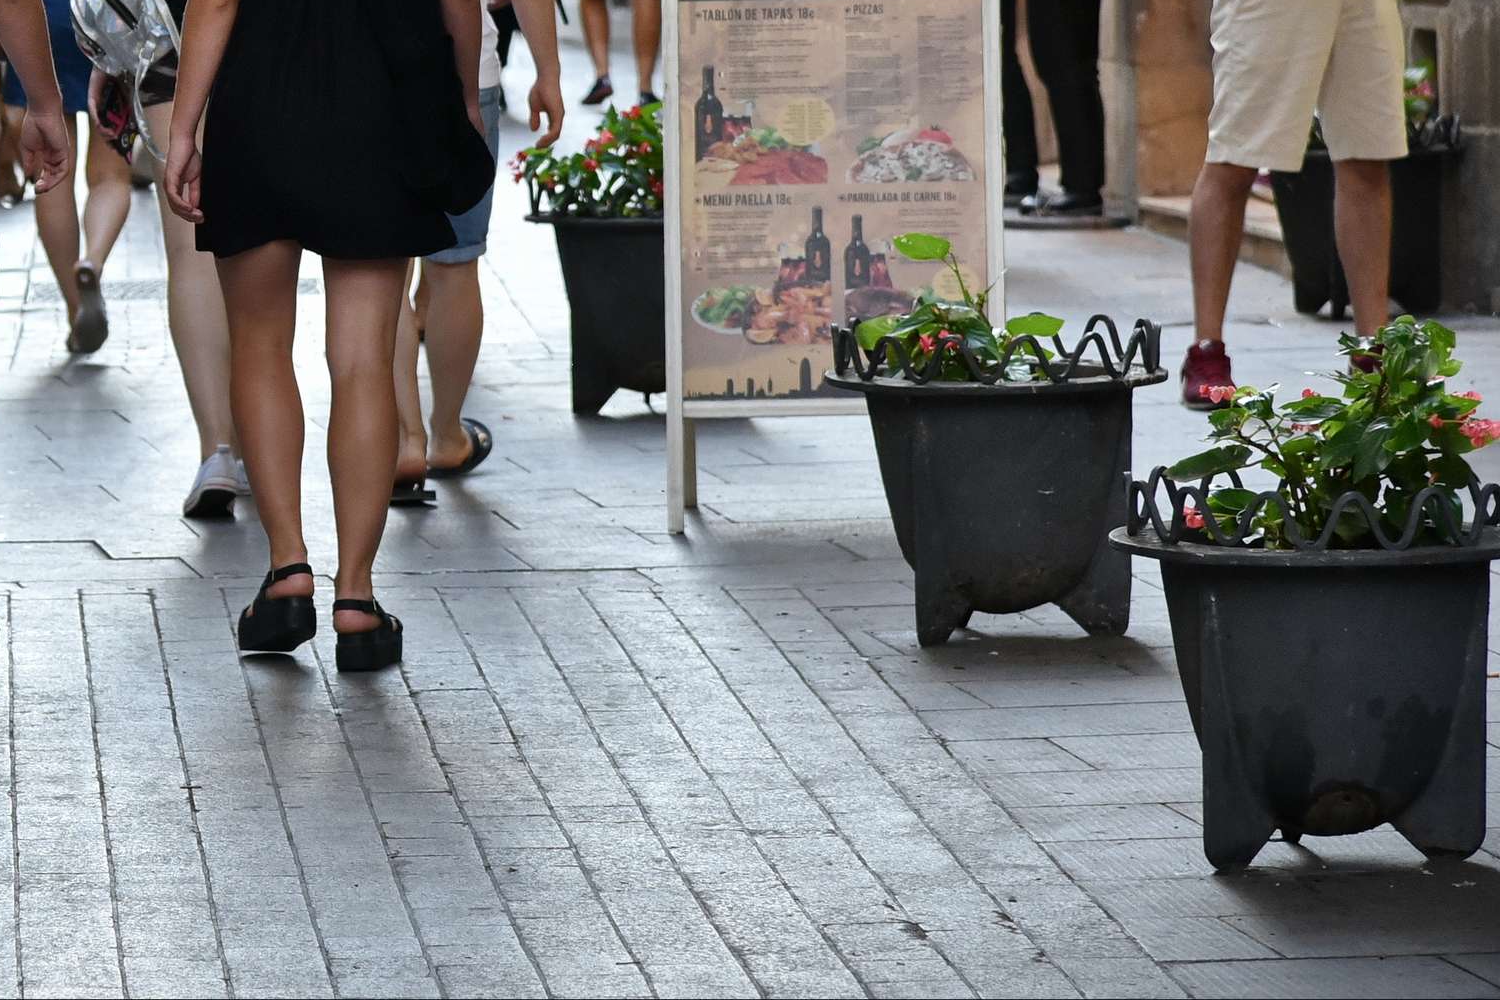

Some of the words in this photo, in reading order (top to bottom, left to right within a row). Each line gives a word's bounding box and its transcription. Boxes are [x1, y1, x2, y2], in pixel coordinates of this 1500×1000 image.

[744, 8, 758, 20] DE
[762, 7, 793, 19] TAPAS
[852, 4, 884, 15] PIZZAS
[734, 193, 773, 206] PAELLA
[847, 191, 898, 202] PARRILLADA
[900, 191, 911, 202] DE
[913, 191, 940, 201] CARNE
